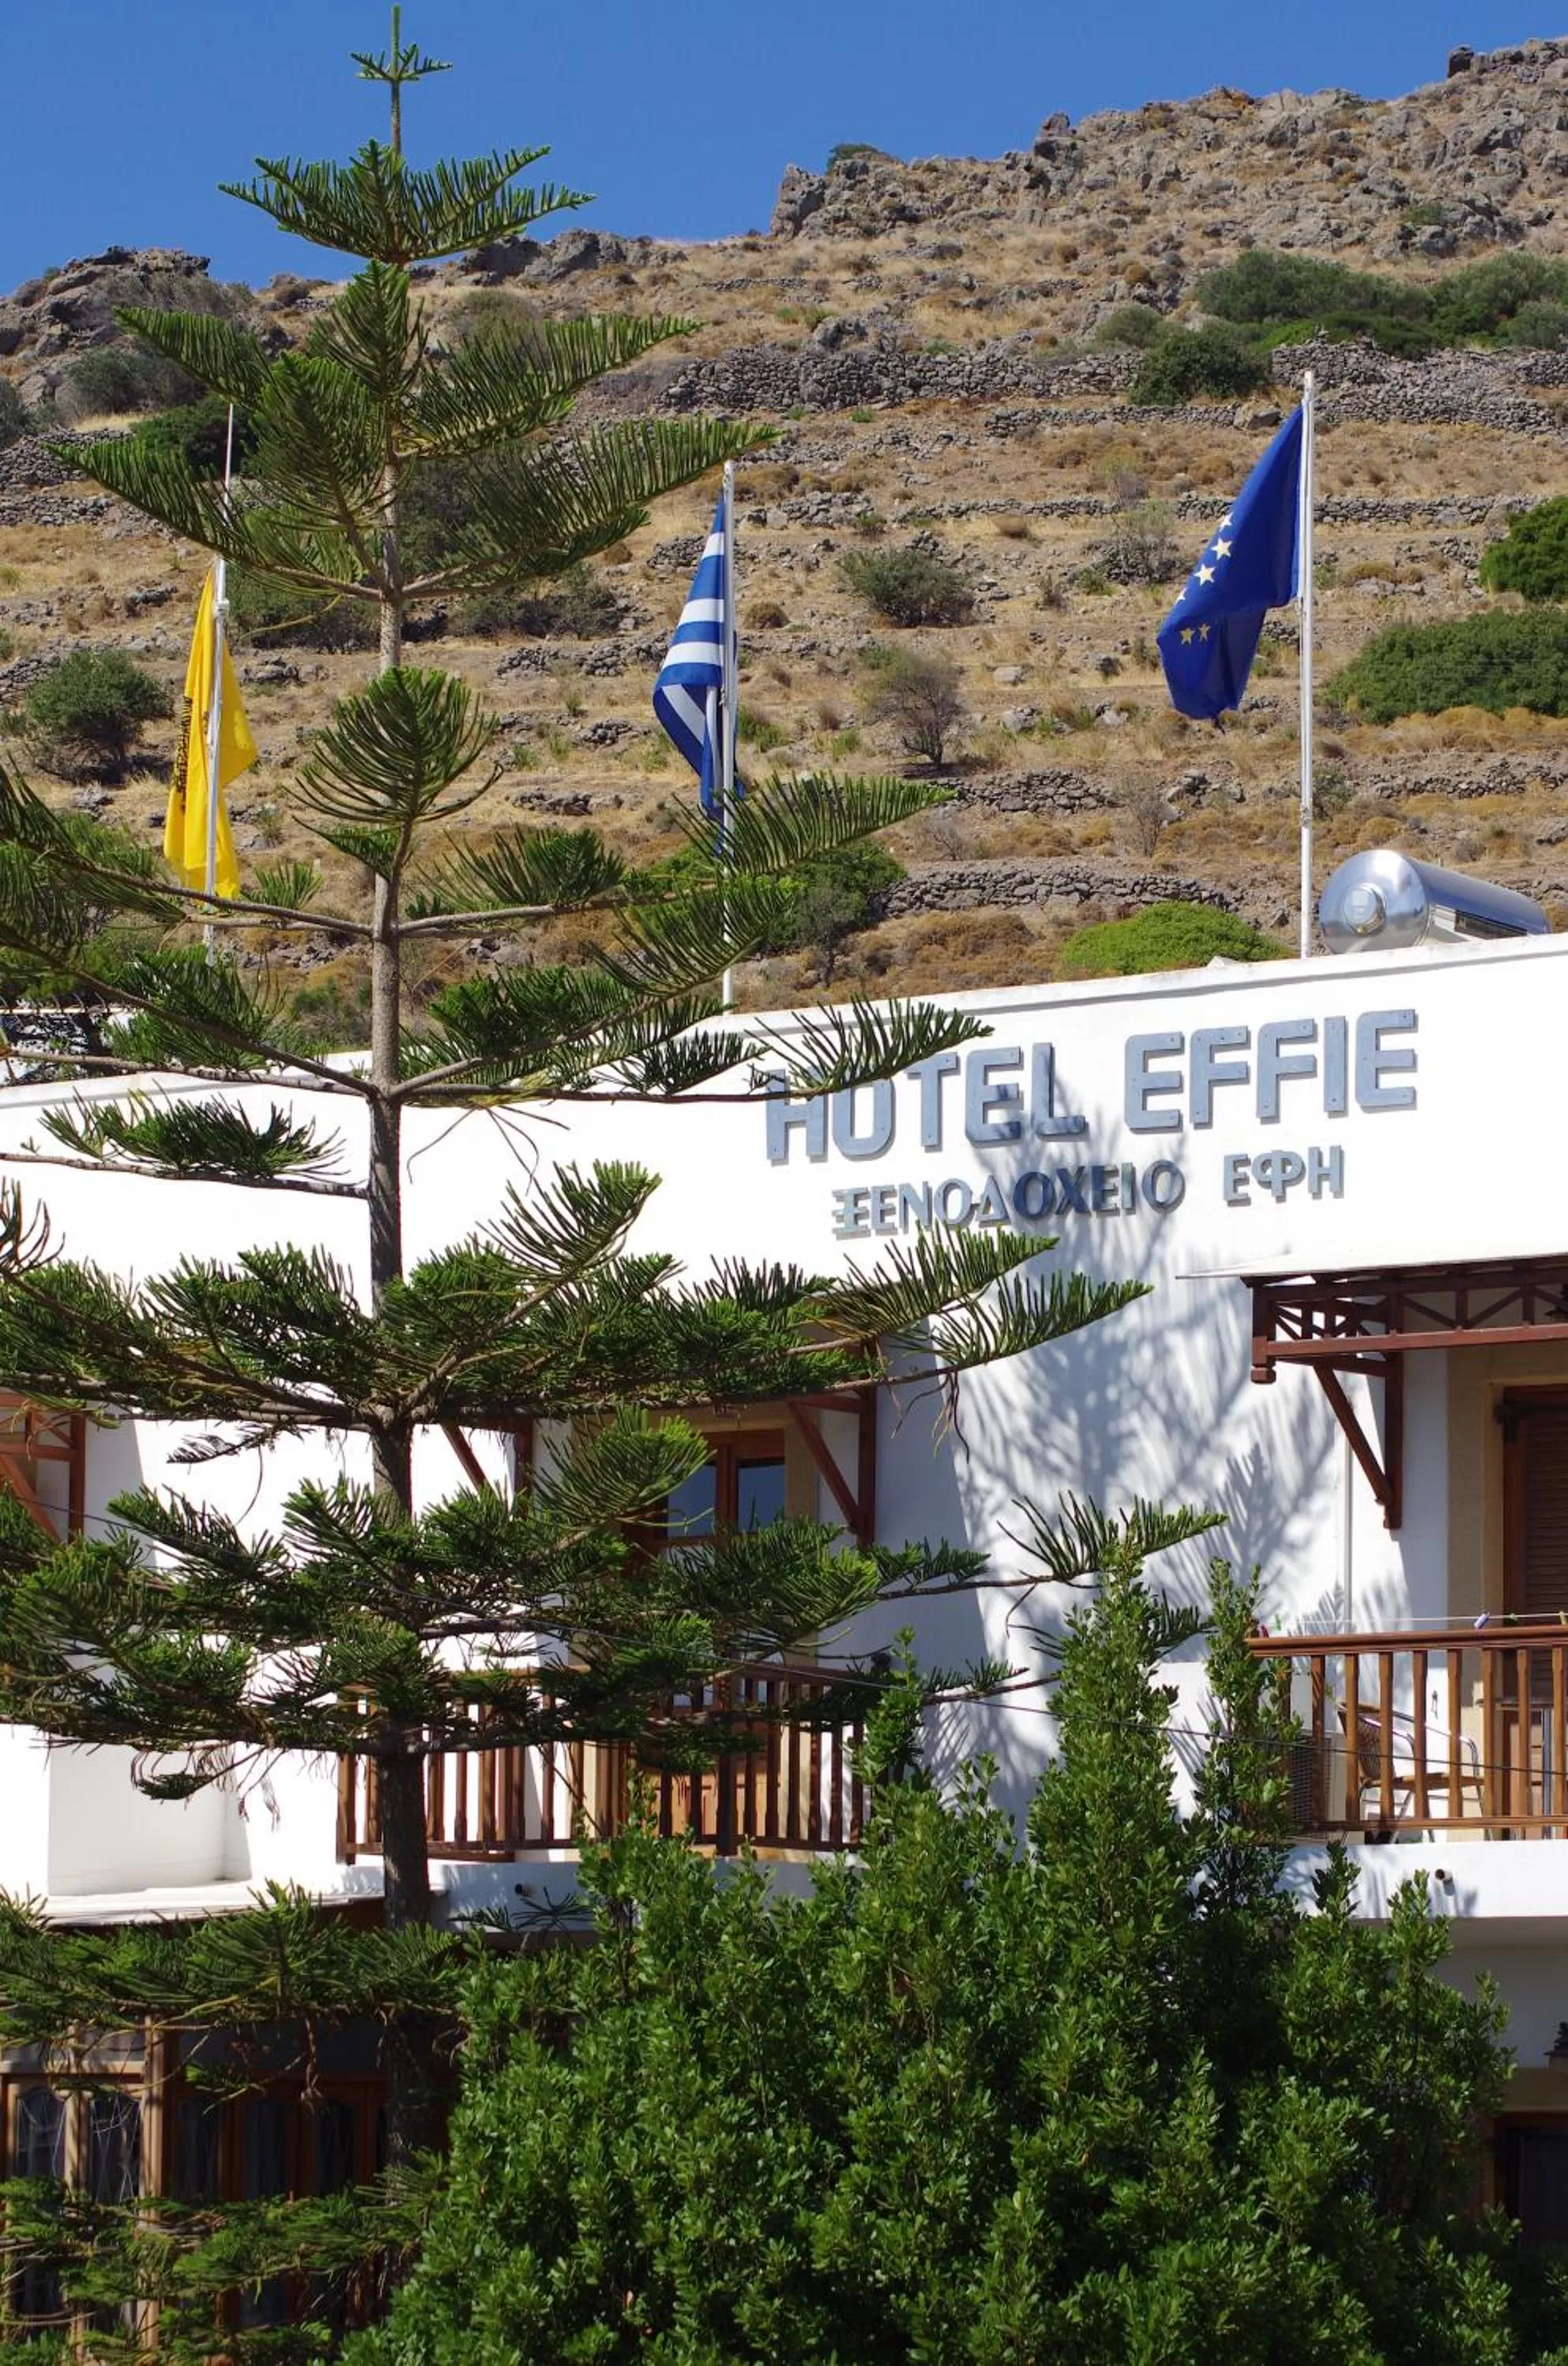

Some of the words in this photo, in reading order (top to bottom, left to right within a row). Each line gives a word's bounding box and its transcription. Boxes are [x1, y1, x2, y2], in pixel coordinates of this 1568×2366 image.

[766, 1043, 1085, 1160] HOTEL
[1125, 1009, 1416, 1129] EFFIE
[833, 1159, 1185, 1234] ΞΕΝΟΔΟΧΕΙΟ
[1223, 1144, 1342, 1202] ΕΦΗ
